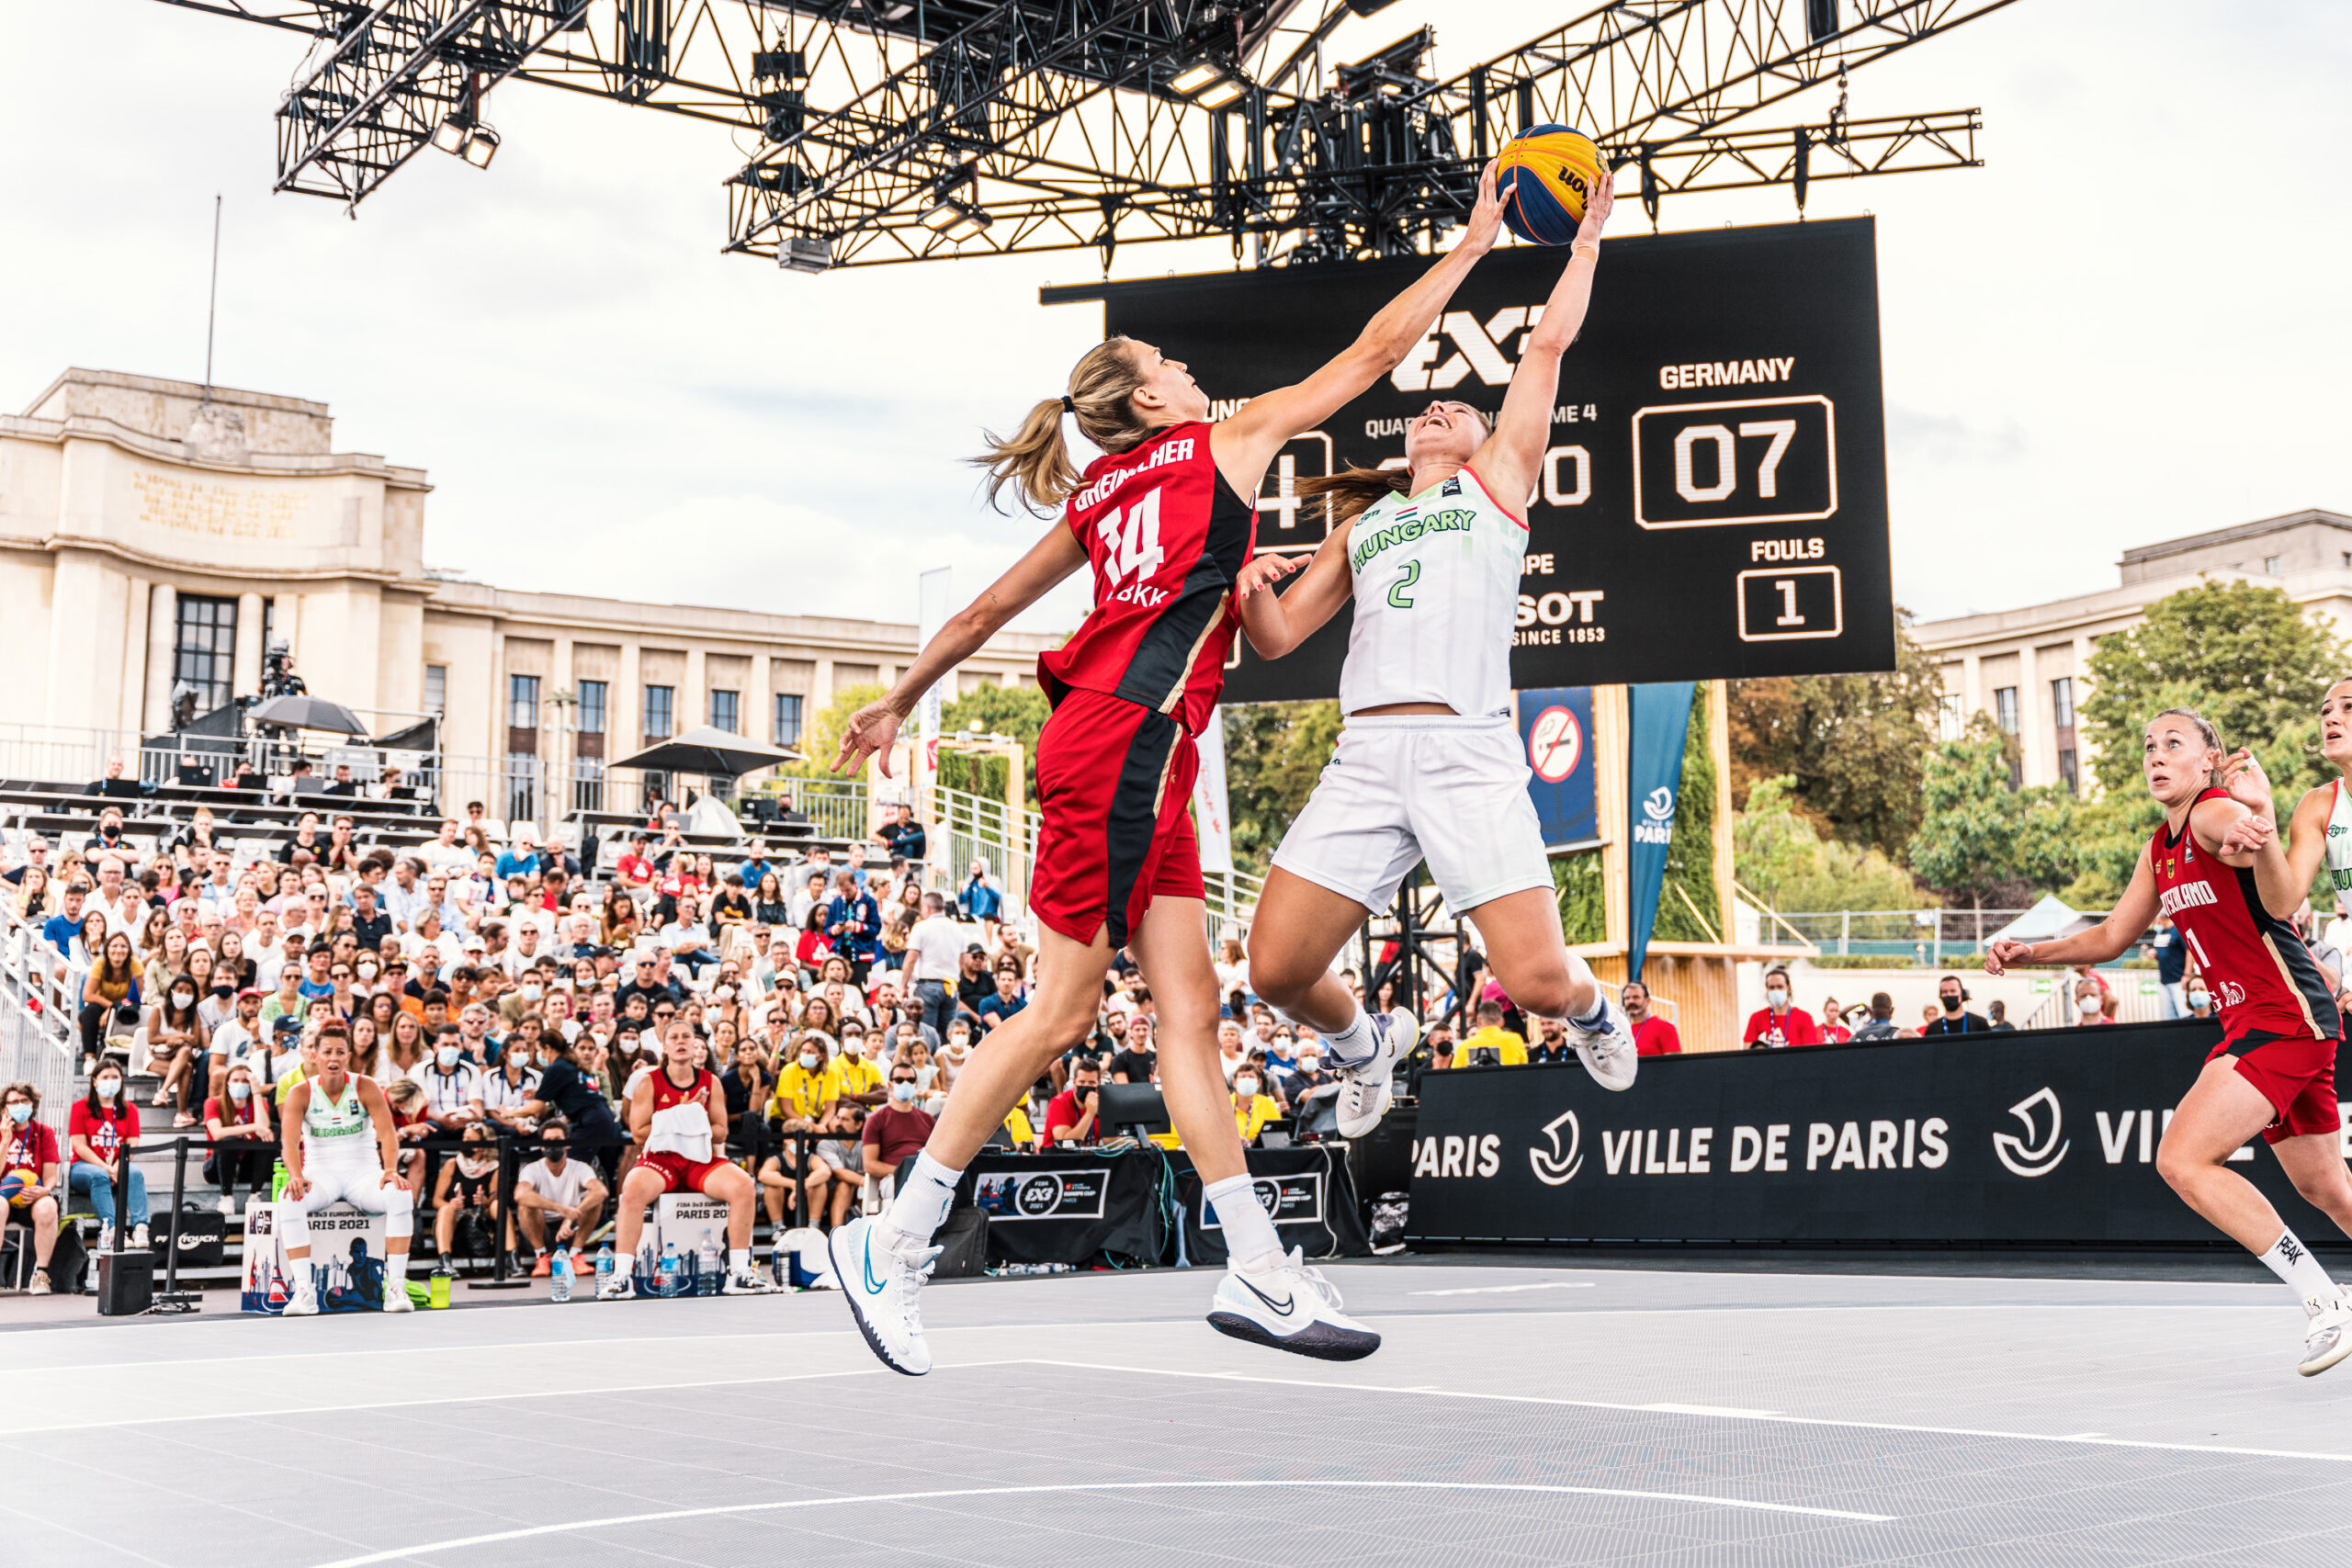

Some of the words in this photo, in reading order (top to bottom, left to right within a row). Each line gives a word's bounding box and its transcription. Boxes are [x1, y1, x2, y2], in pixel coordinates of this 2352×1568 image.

[1659, 356, 1795, 389] GERMANY
[1583, 403, 1598, 422] 4
[1673, 419, 1797, 502] 07
[1096, 485, 1164, 588] 14
[1352, 509, 1476, 575] HUNGARY
[1751, 537, 1825, 562] FOULS
[1387, 559, 1421, 609] 2
[1774, 580, 1805, 626] 1
[1511, 628, 1562, 647] SINCE
[1567, 626, 1605, 643] 1853
[1601, 1128, 1713, 1175] VILLE
[1730, 1124, 1791, 1172] DE
[1806, 1117, 1949, 1171] PARIS
[339, 1219, 370, 1230] 2021
[676, 1209, 710, 1220] PARIS
[713, 1209, 728, 1219] 20
[2276, 1235, 2304, 1267] PEAK
